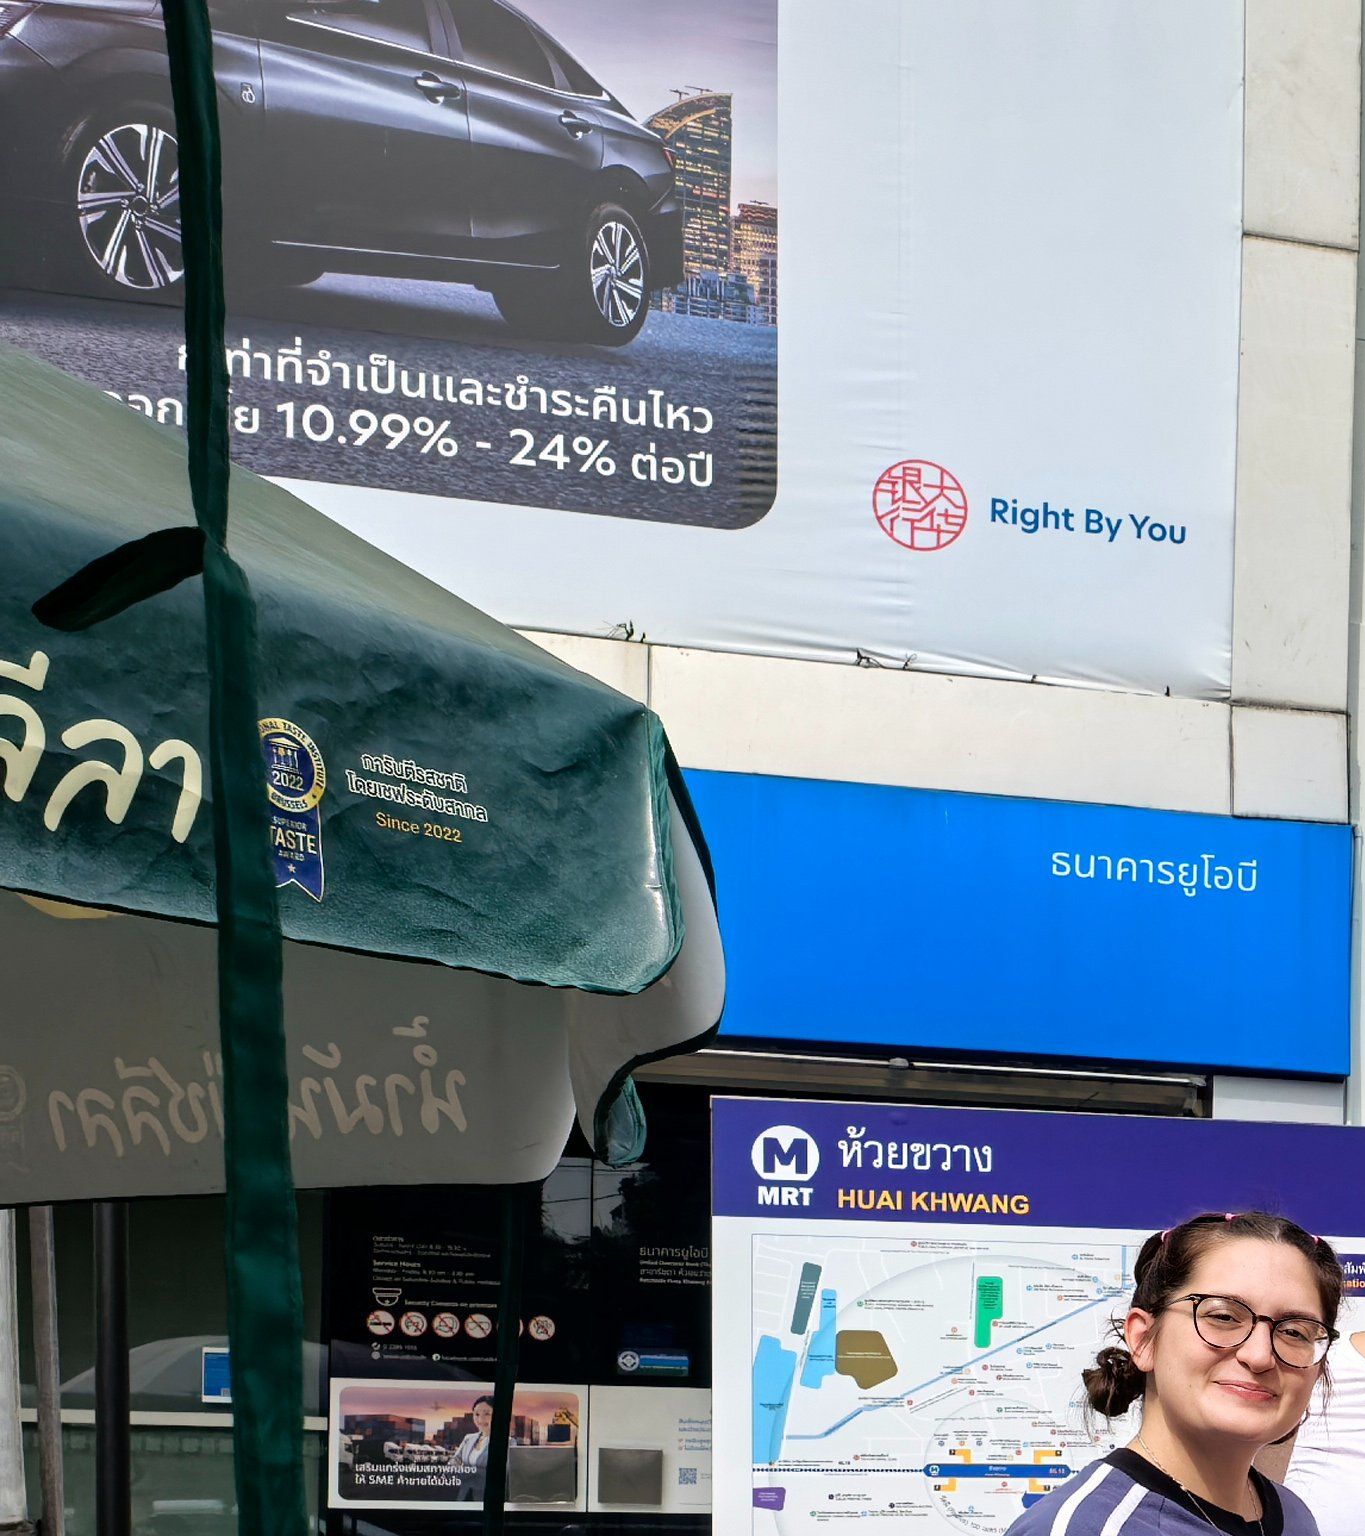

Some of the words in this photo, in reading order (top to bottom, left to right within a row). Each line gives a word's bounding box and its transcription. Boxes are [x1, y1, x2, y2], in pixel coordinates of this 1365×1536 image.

[277, 402, 458, 457] 10.99%
[509, 429, 616, 476] 24%
[631, 443, 713, 487] ต่อปี
[991, 498, 1074, 533] Right
[1085, 509, 1122, 542] By
[1129, 514, 1186, 544] You
[272, 770, 304, 792] 2022
[270, 826, 317, 854] TASTE
[375, 812, 420, 834] Since
[424, 822, 463, 843] 2022
[1051, 852, 1258, 897] ธนาคารยูโอบี
[837, 1125, 993, 1173] ห้วยขวาง
[757, 1185, 814, 1206] MRT
[837, 1189, 903, 1211] HUAI
[911, 1191, 1030, 1214] KHWANG
[368, 1475, 394, 1485] SME
